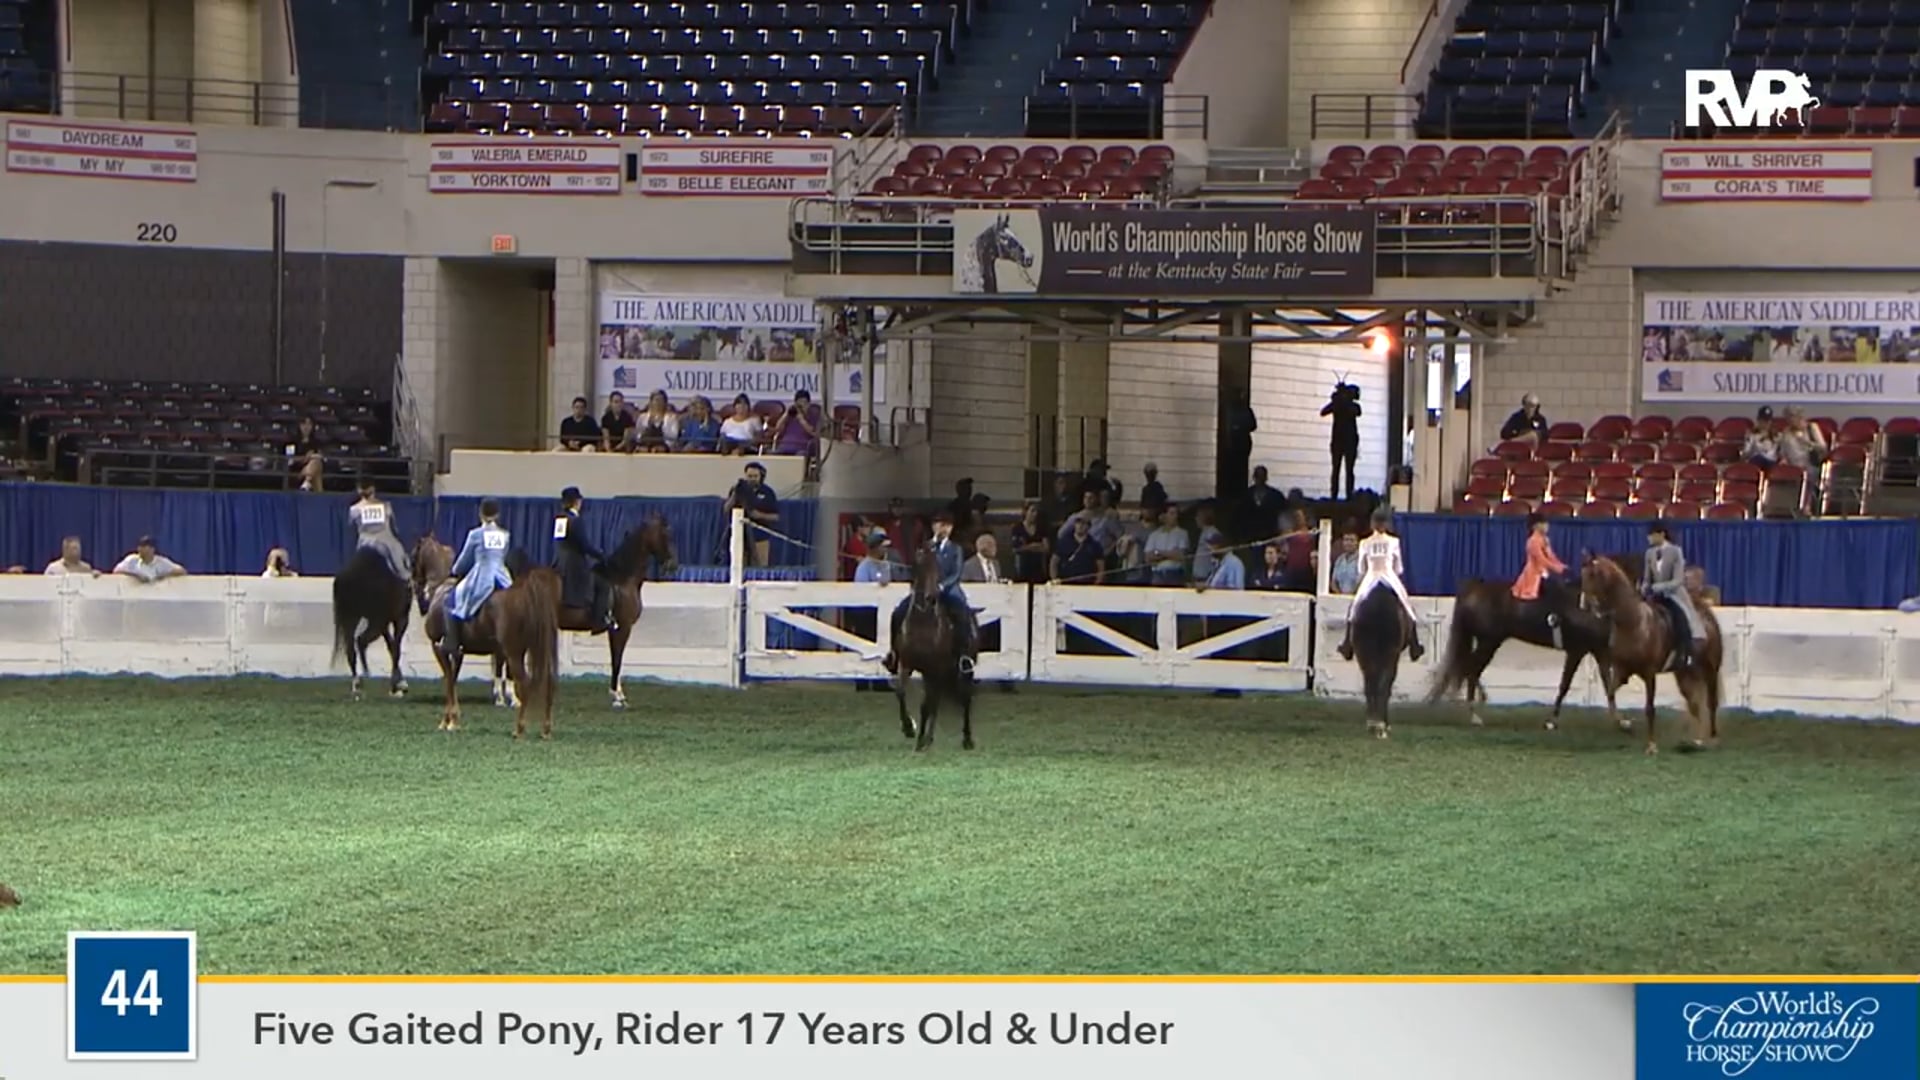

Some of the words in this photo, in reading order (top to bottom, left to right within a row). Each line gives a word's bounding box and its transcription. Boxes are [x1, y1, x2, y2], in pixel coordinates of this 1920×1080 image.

[62, 130, 144, 148] DAYDREAM
[471, 149, 522, 162] VALERIA
[527, 149, 588, 162] EMERALD
[700, 151, 774, 164] SUREFIRE
[1705, 154, 1743, 167] WILL
[1751, 154, 1823, 167] SHRIVER
[79, 157, 100, 171] MY
[105, 159, 125, 172] MY
[471, 174, 551, 187] YORKTOWN
[678, 177, 723, 190] BELLE
[730, 177, 796, 190] ELEGANT
[1714, 180, 1778, 194] CORA'S
[1787, 180, 1824, 194] TIME
[137, 223, 177, 243] 220
[1052, 221, 1118, 253] World's
[1125, 222, 1248, 259] Championship
[1254, 224, 1307, 253] Horse
[1313, 222, 1362, 253] Show
[1108, 264, 1124, 279] at
[1128, 262, 1151, 279] the
[1155, 262, 1227, 283] Kentucky
[1230, 262, 1268, 279] State
[1272, 262, 1304, 279] Fair
[612, 300, 649, 320] THE
[654, 301, 747, 322] AMERICAN
[1657, 300, 1696, 321] THE
[1702, 300, 1804, 321] AMERICAN
